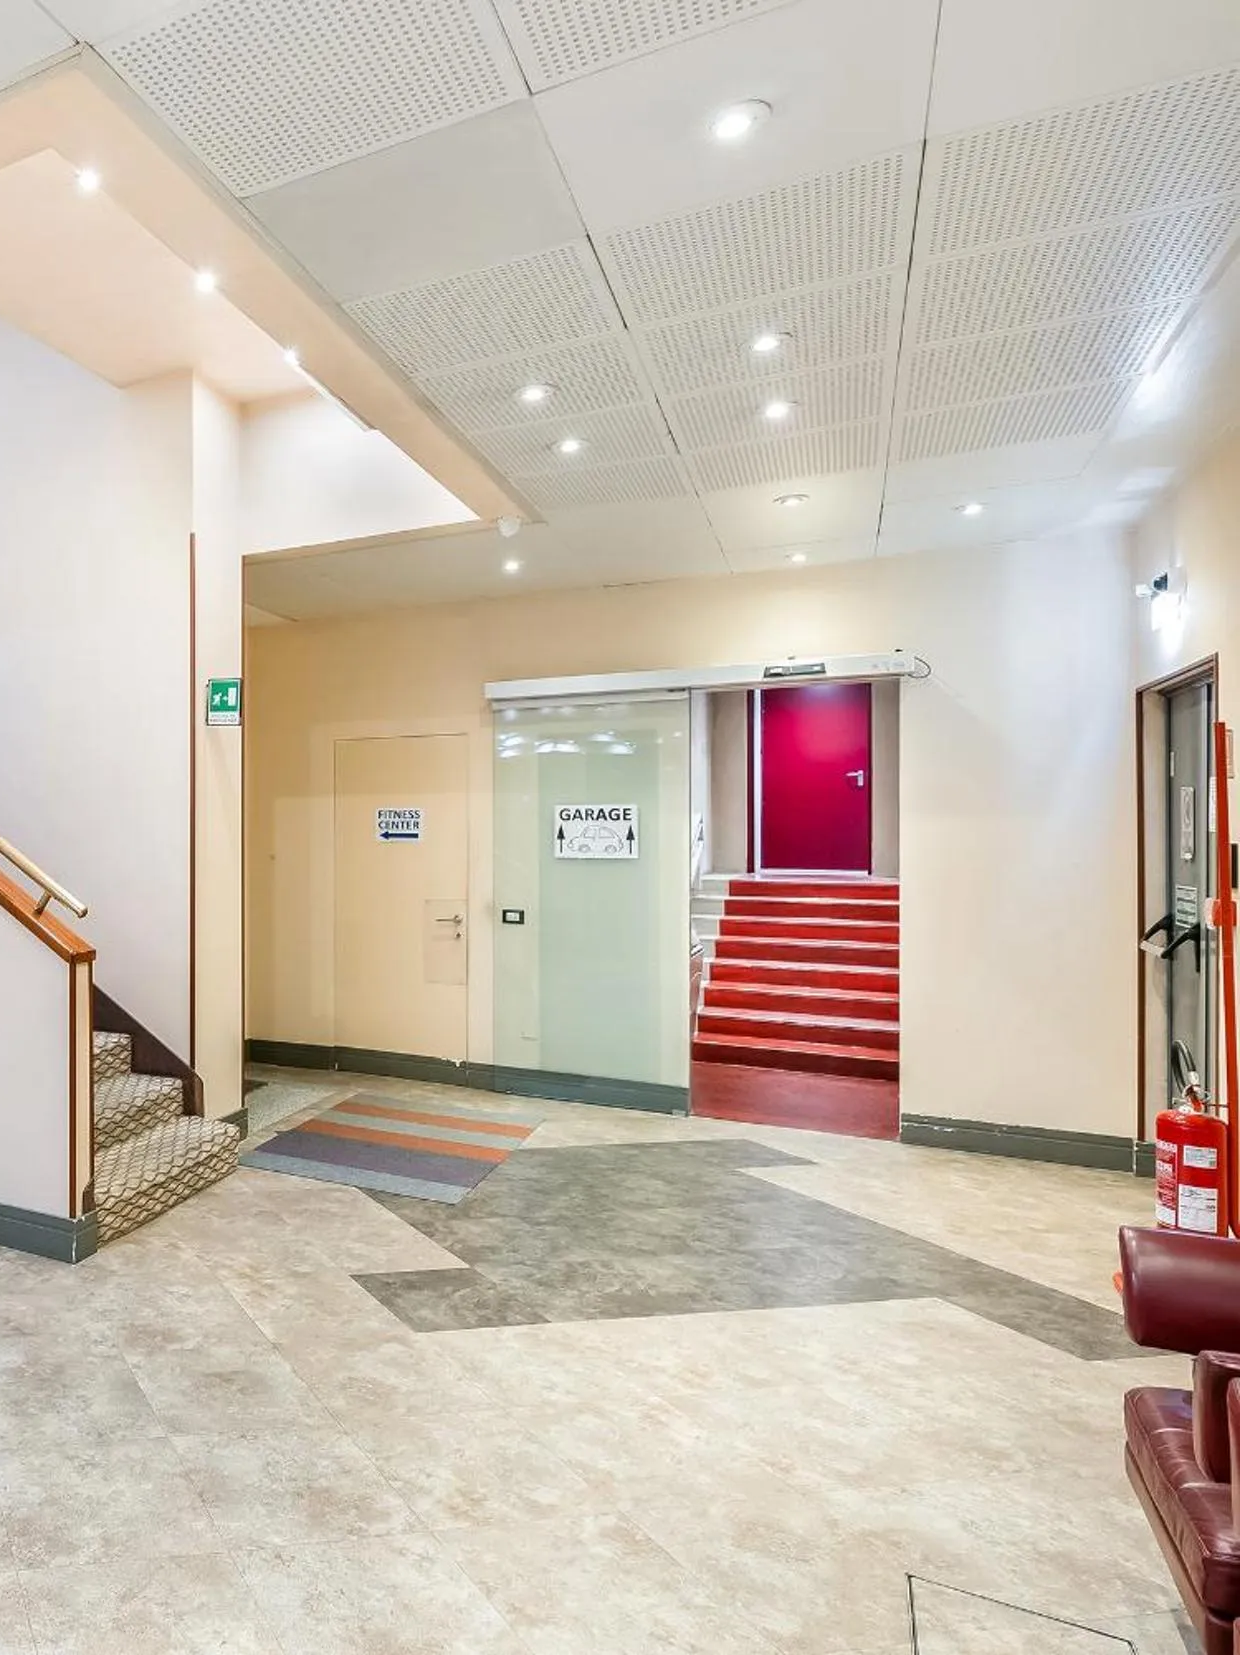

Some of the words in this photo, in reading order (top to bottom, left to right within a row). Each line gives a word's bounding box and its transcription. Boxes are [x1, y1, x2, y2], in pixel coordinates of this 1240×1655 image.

[378, 810, 421, 819] FITNESS
[559, 808, 632, 821] GARAGE
[378, 820, 419, 830] CENTER
